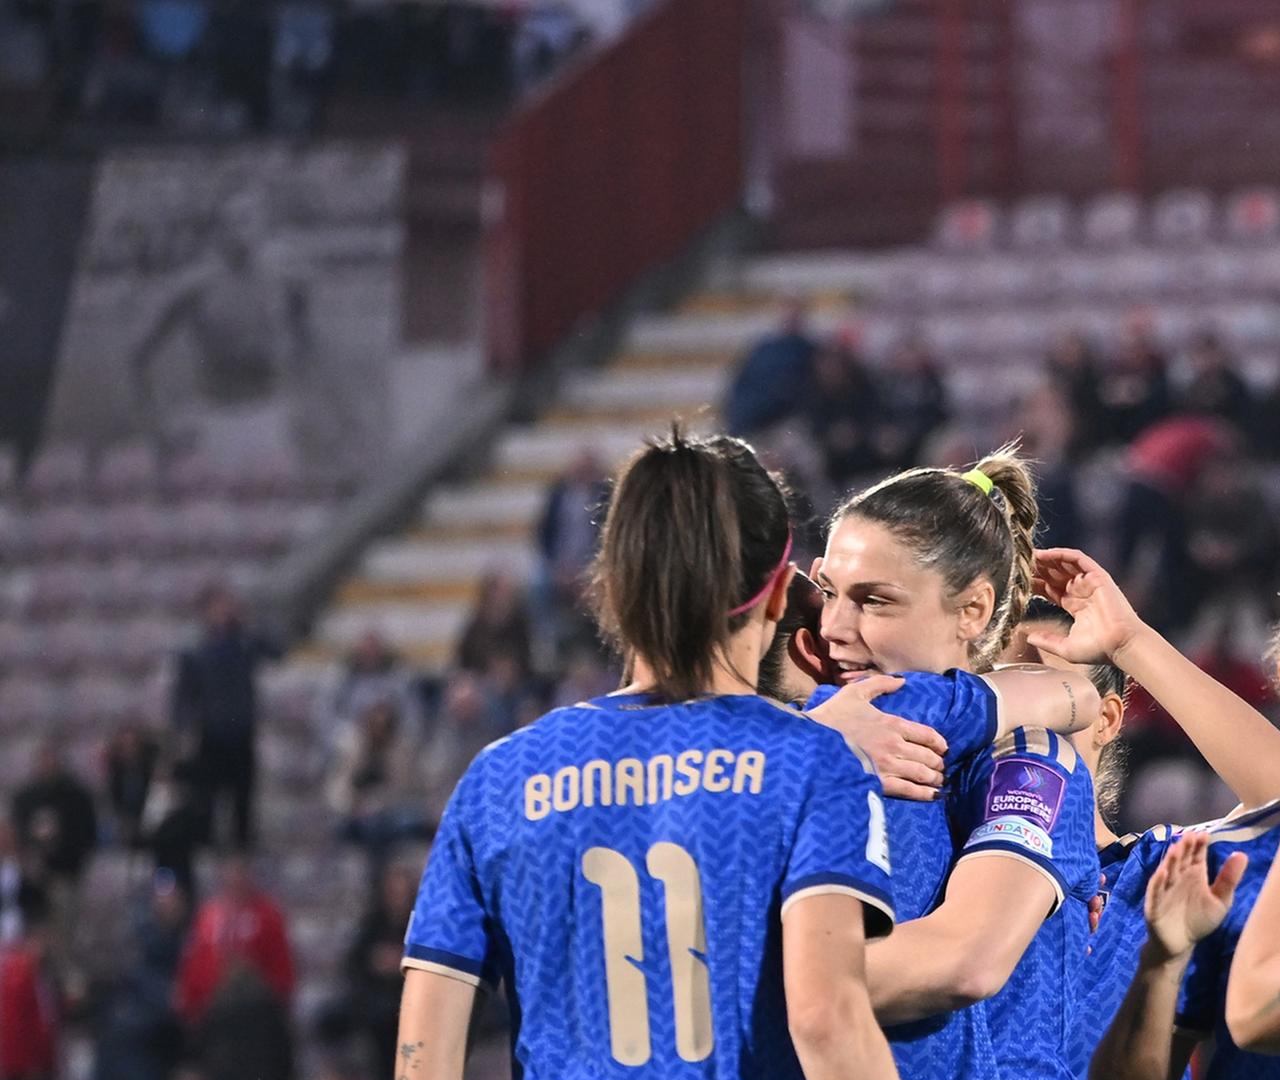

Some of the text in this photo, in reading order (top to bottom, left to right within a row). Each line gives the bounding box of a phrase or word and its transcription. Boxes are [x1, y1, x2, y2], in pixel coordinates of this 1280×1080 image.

[523, 749, 766, 821] BONANSEA
[993, 795, 1052, 815] EUROPEAN
[991, 803, 1051, 824] QUALIFIERS
[582, 842, 713, 1067] 11
